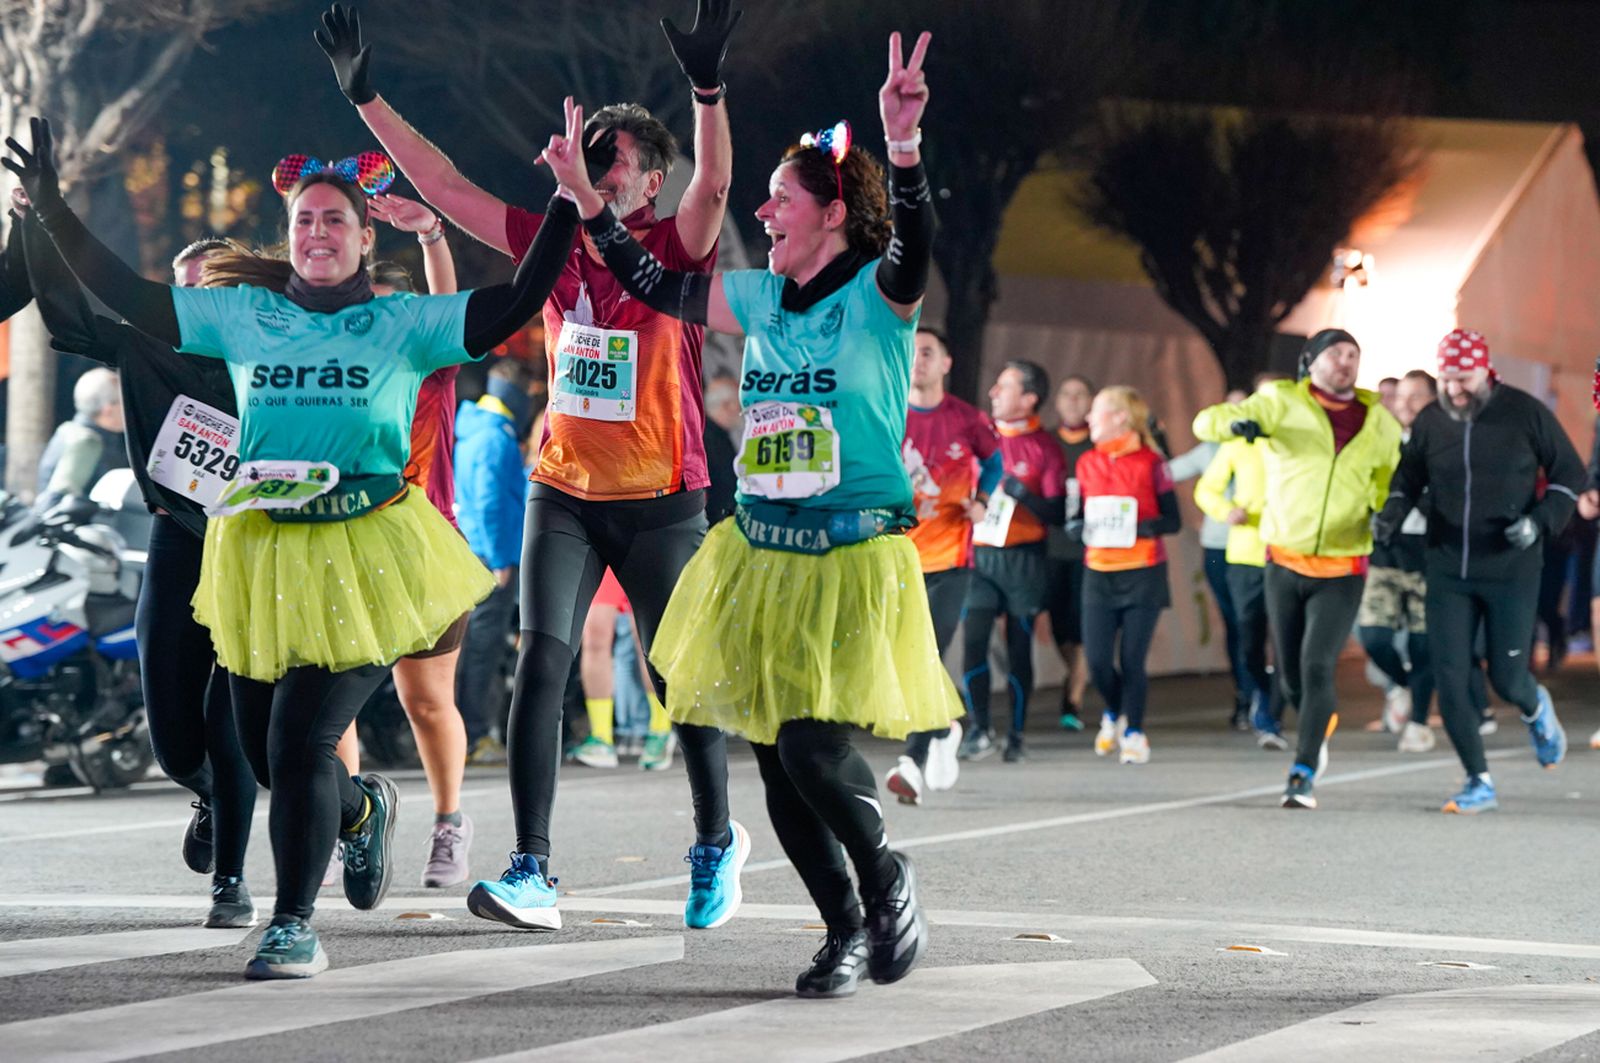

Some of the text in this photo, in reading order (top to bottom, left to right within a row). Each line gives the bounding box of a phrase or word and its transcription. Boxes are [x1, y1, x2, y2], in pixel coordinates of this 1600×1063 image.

[592, 339, 600, 348] DE
[250, 358, 370, 390] serás
[565, 358, 617, 390] 4025
[741, 363, 838, 394] serás
[264, 396, 287, 407] QUE
[294, 396, 344, 408] QUIERAS
[350, 396, 368, 408] SER
[177, 418, 198, 433] SAN
[198, 427, 231, 448] ANTÓN
[193, 412, 222, 432] NOCHE
[222, 426, 236, 438] DE
[174, 432, 240, 482] 5329
[756, 430, 815, 466] 6159
